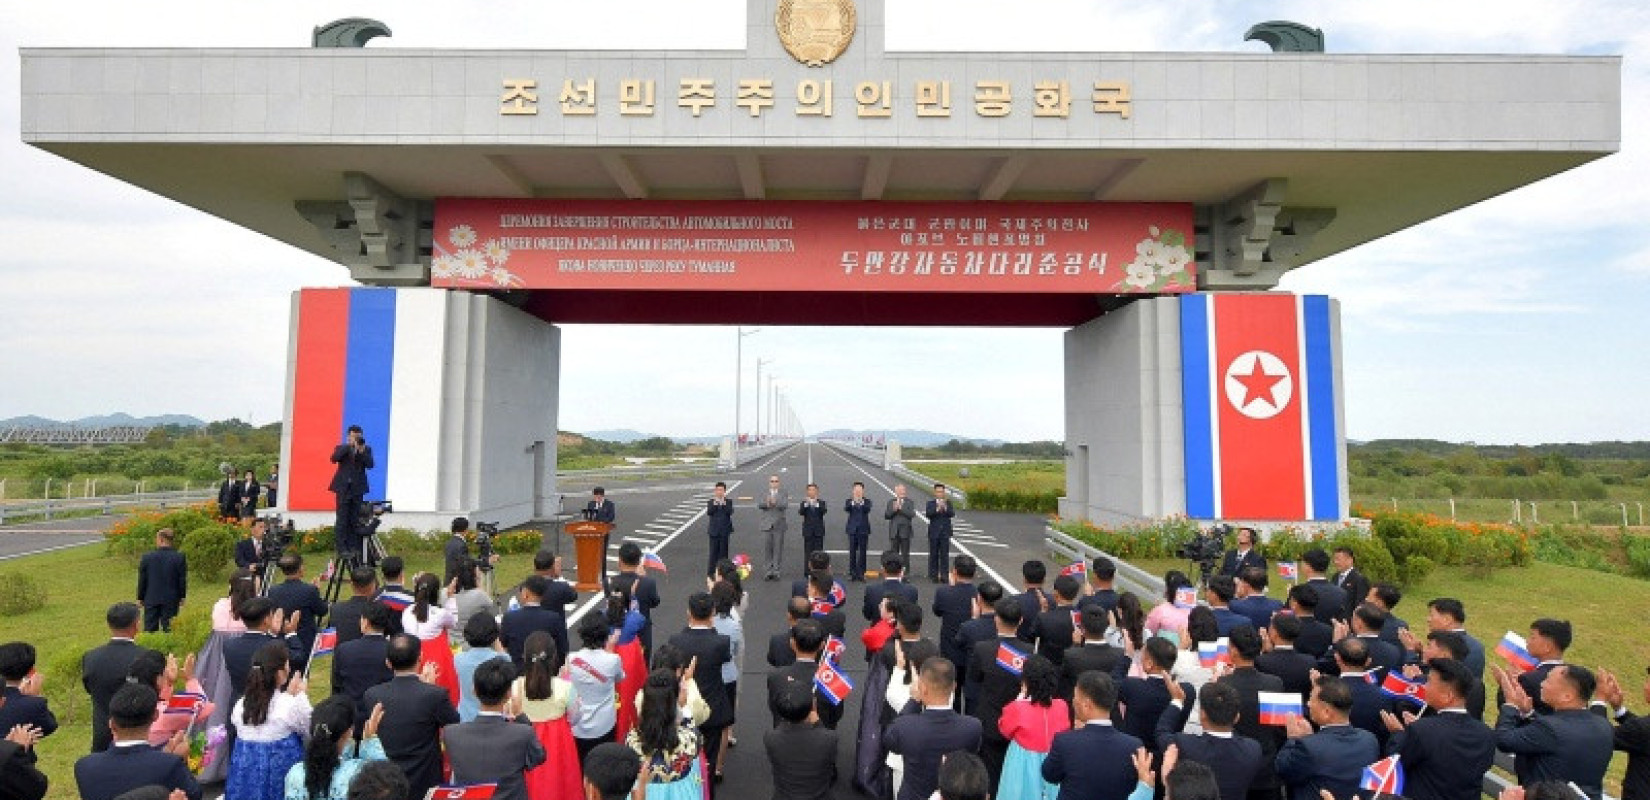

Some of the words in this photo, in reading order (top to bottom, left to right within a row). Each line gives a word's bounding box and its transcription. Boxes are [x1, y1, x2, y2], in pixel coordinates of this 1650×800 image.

[500, 78, 1132, 118] 조선민주주의인민공화국
[611, 215, 680, 229] СТРОИТЕЛЬСТВА
[682, 216, 762, 229] АВТОМОБИЛЬНОГО
[763, 216, 794, 229] МОСТА
[1000, 217, 1089, 231] 국제주의전사
[534, 236, 574, 252] ОФИЦЕРА
[577, 234, 618, 250] КРАСНОЙ
[620, 238, 651, 250] АРМИИ
[653, 238, 661, 250] И
[662, 238, 795, 253] БОРЦА-ИНТЕРНАЦИОНАЛИСТА
[840, 251, 1108, 275] 두만강자동차다리준공식
